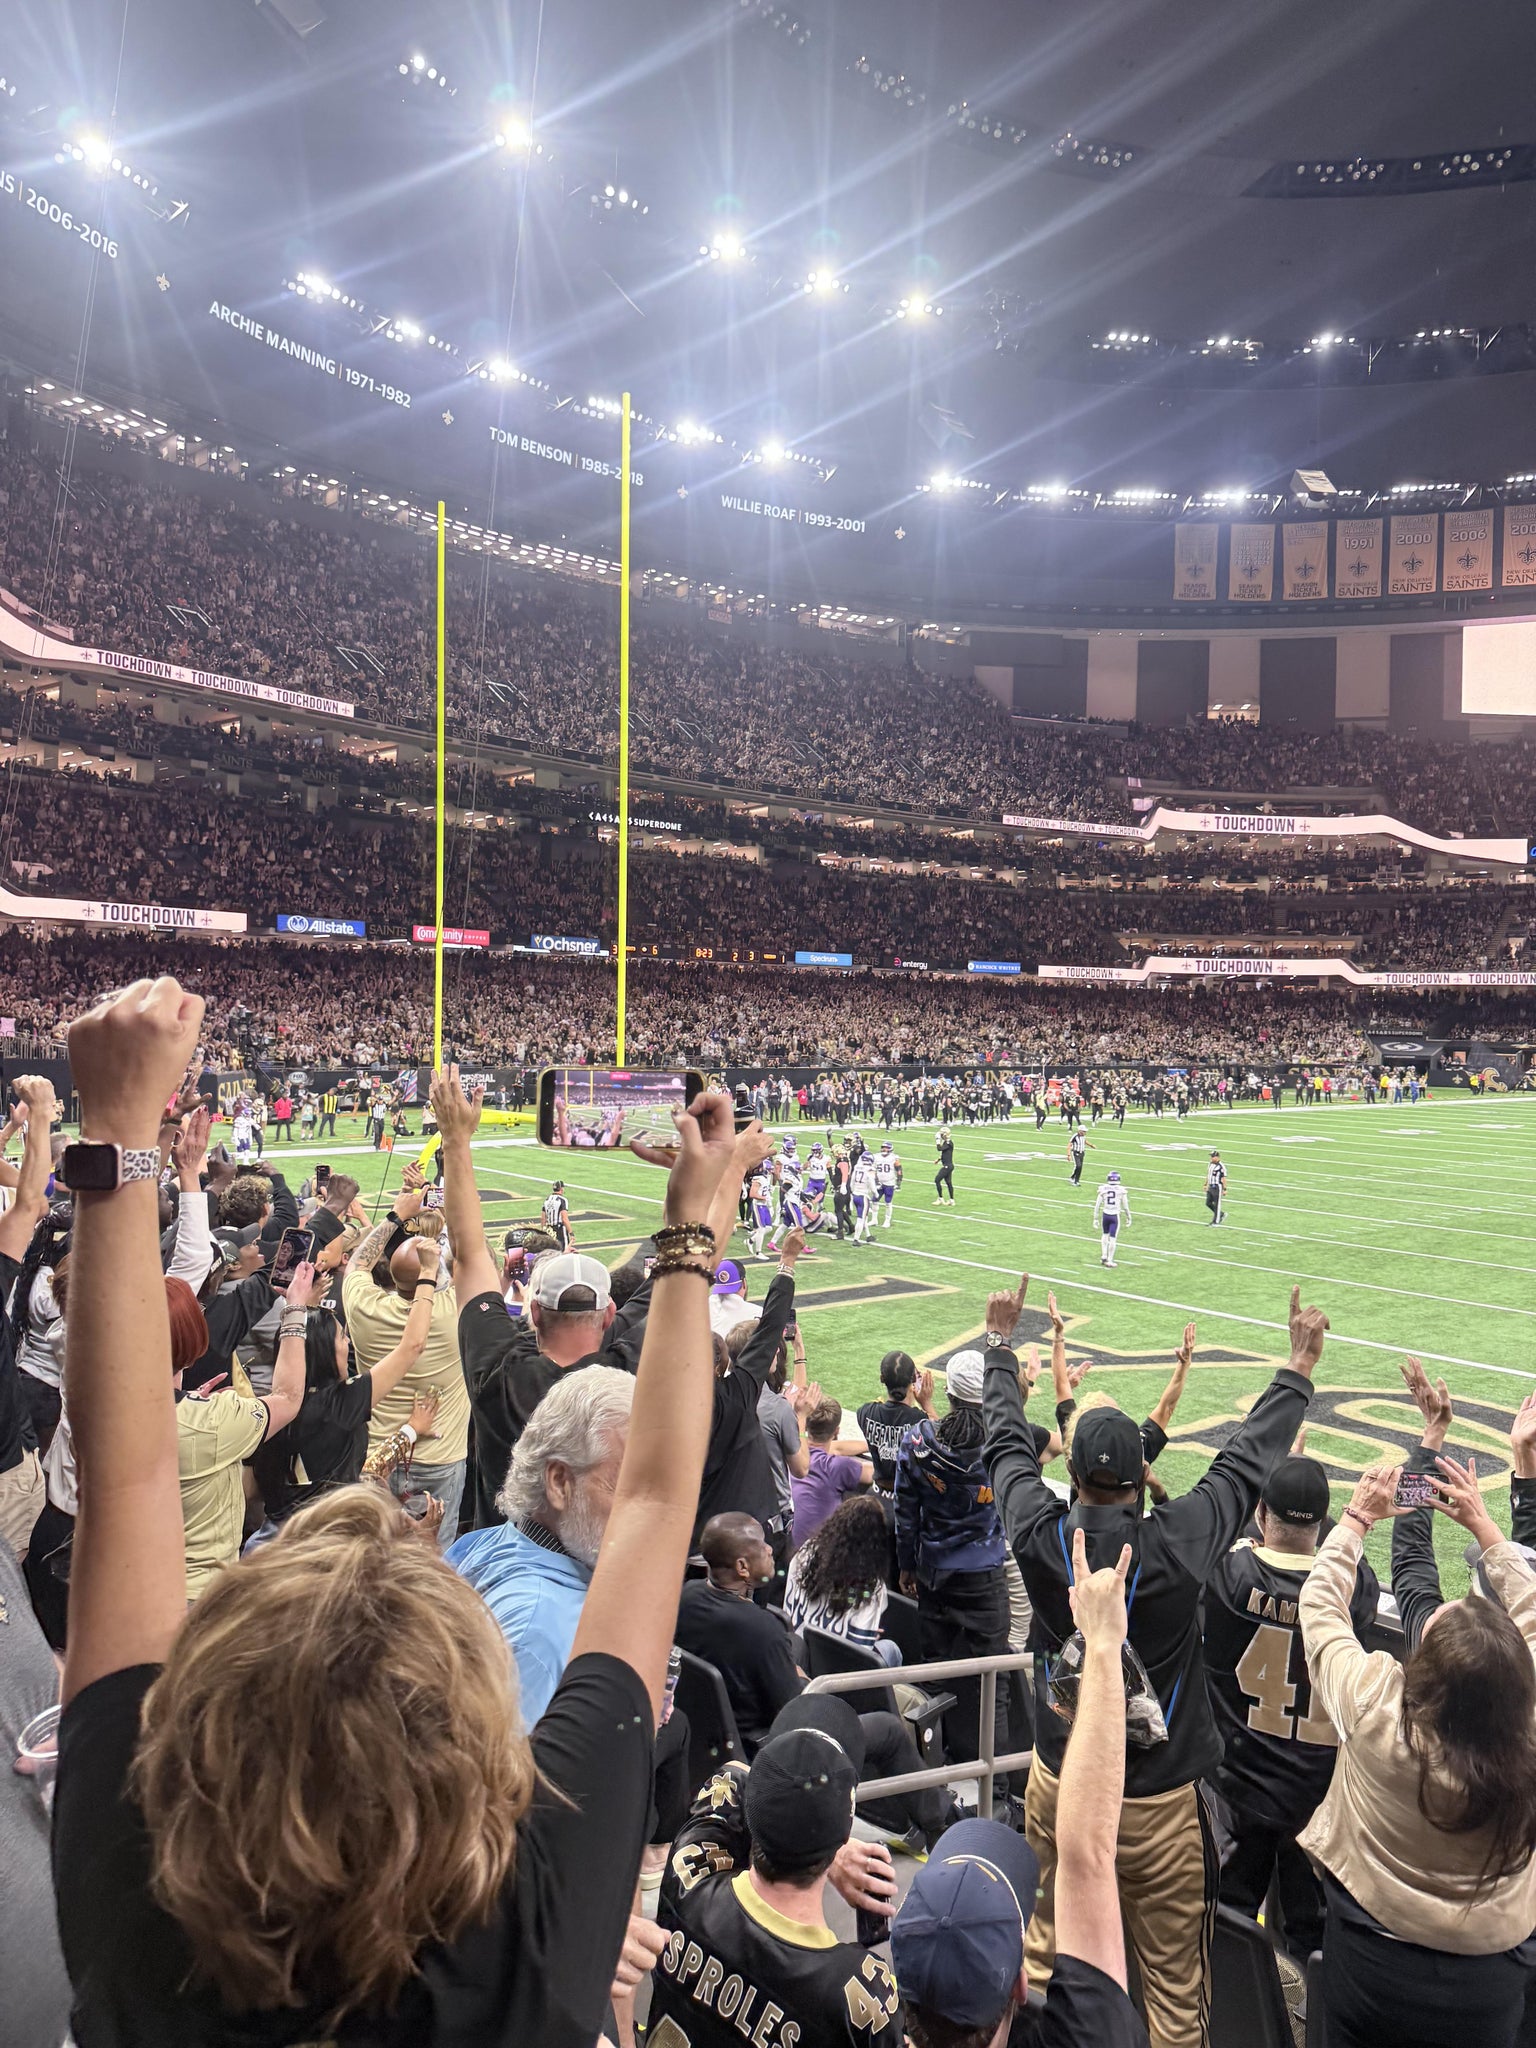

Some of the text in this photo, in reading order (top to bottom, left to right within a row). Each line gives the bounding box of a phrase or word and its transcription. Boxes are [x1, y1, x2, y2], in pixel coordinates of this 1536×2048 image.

[26, 188, 118, 258] 2006-2016
[209, 301, 411, 408] ARCHIE MANNING 1971-1982
[489, 426, 644, 486] TOM BENSON 1985-218
[721, 494, 866, 533] WILLIE ROAF 1993-2001
[1397, 533, 1432, 545] 2000
[1450, 529, 1487, 542] 2006
[1345, 537, 1374, 549] 1991
[1338, 586, 1378, 596] SAINTS
[1392, 582, 1433, 592] SAINTS
[1447, 578, 1488, 590] SAINTS
[97, 651, 339, 713] TOUCHDOWN TOUCHDOWN TOUCHDOWN
[368, 711, 406, 727] SAINTS
[530, 742, 564, 757] SAINTS
[603, 757, 633, 771] SAIS
[302, 768, 339, 783] SAINTS
[670, 769, 699, 781] SAINTS
[588, 811, 682, 831] CAESAS SUPERDOME
[1012, 816, 1140, 836] TOUCHDOWN TOUCHDOWN TOUCHDOWN
[1214, 815, 1295, 833] TOUCHDOWN
[101, 904, 196, 926] TOUCHDOWN
[369, 924, 407, 936] SAINTS
[417, 926, 463, 942] Comunity
[542, 936, 598, 952] Ochsner
[652, 945, 658, 955] 6
[695, 947, 713, 958] 8:23
[810, 954, 838, 963] Spectrum
[902, 961, 928, 970] entergy
[1195, 960, 1273, 973] TOUCHDOWN
[1066, 967, 1113, 979] TOUCHDOWN
[1386, 973, 1536, 984] TOUCHDOWN TOUCHDOWN
[1107, 1191, 1116, 1205] 2
[1286, 1509, 1314, 1519] SAINTS
[664, 1930, 801, 2048] SPROLES
[844, 1954, 900, 2035] 43
